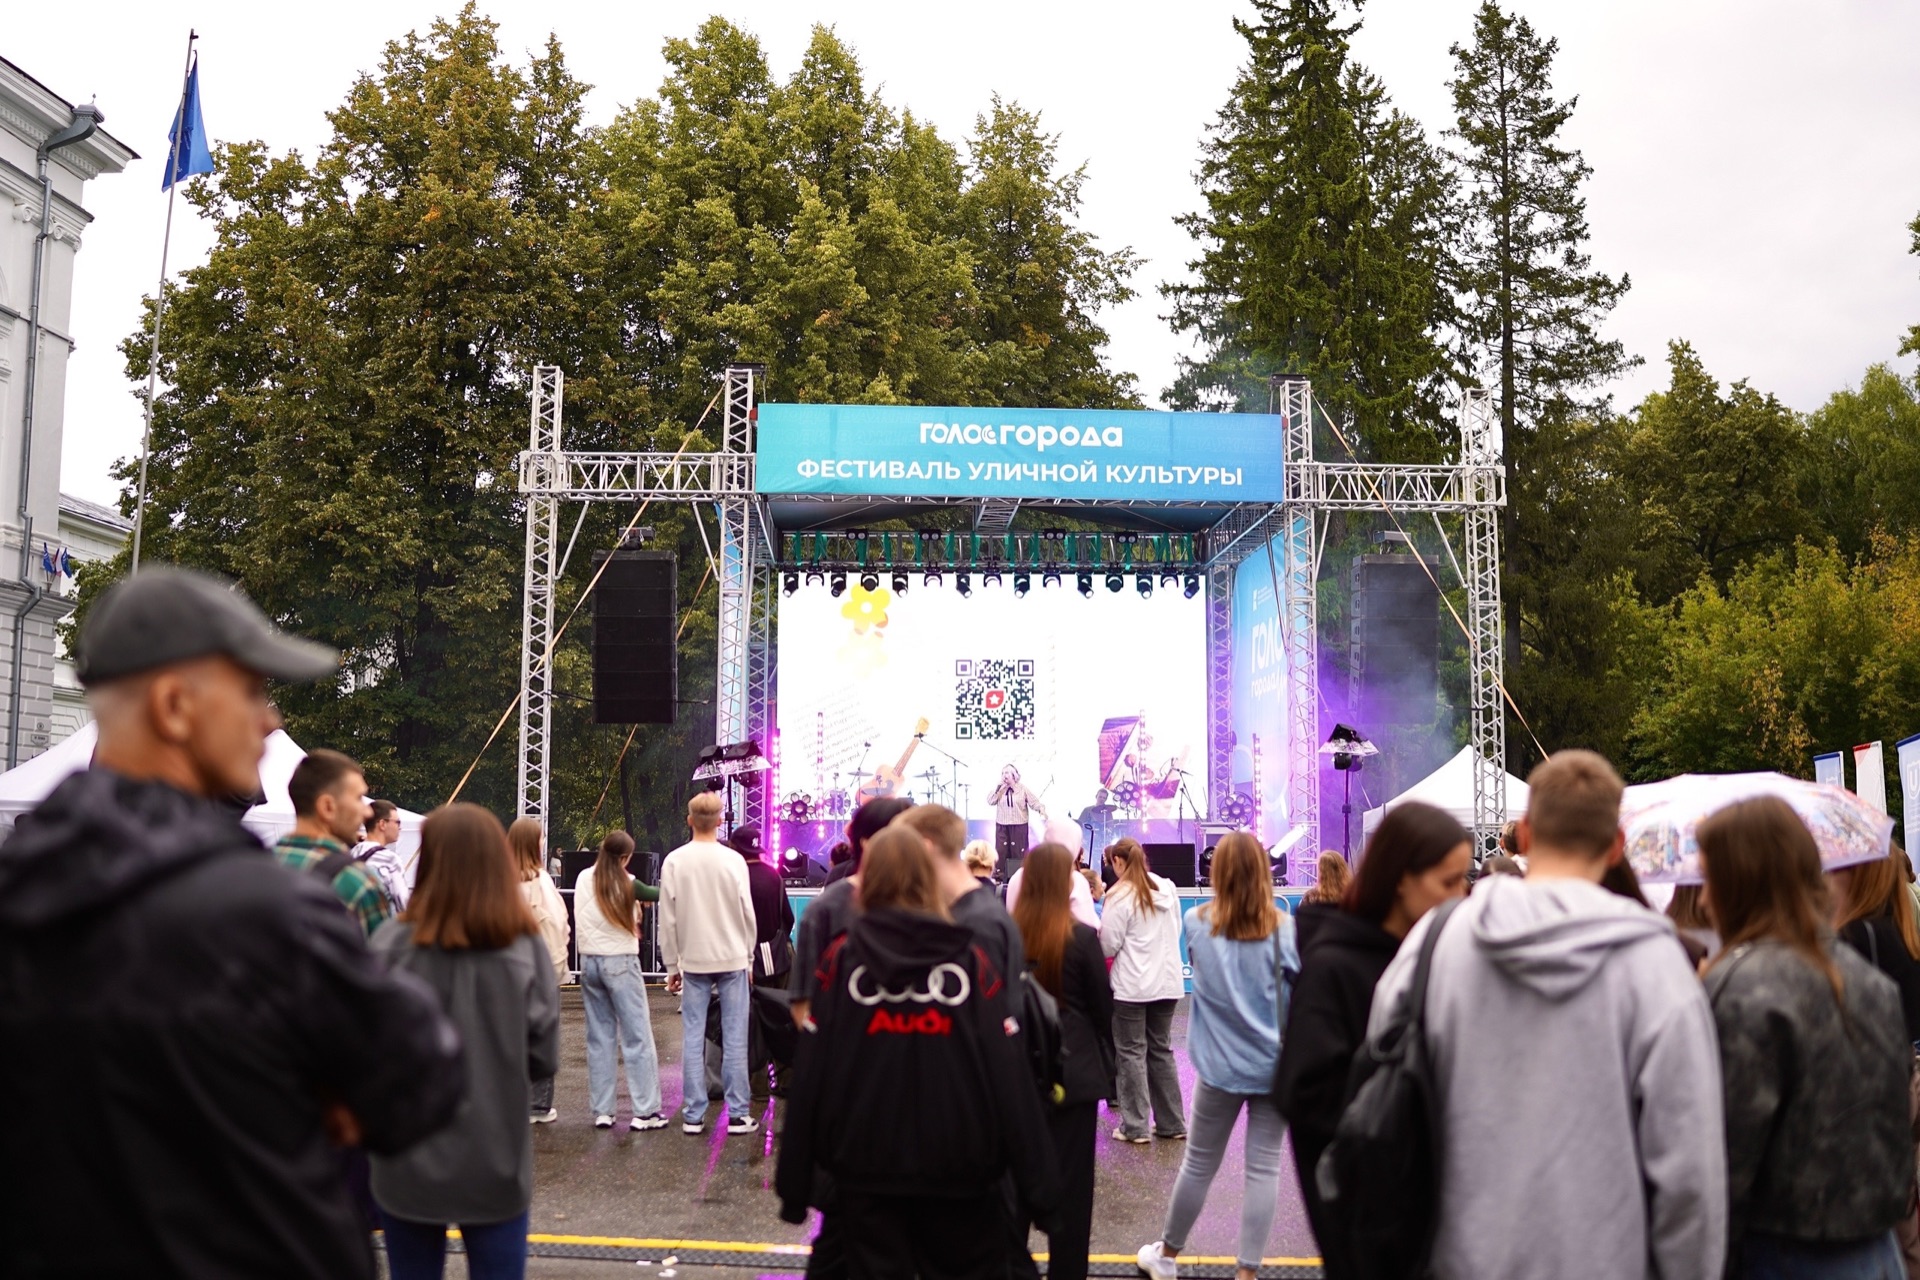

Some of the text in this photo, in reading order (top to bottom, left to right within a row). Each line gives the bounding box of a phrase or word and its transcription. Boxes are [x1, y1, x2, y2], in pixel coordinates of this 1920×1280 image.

[1000, 424, 1123, 452] города
[796, 458, 961, 480] ФЕСТИВАЛЬ
[967, 459, 1098, 483] УЛИЧНОЙ
[1105, 464, 1243, 486] КУЛЬТУРЫ
[1252, 613, 1287, 674] ГОЛО
